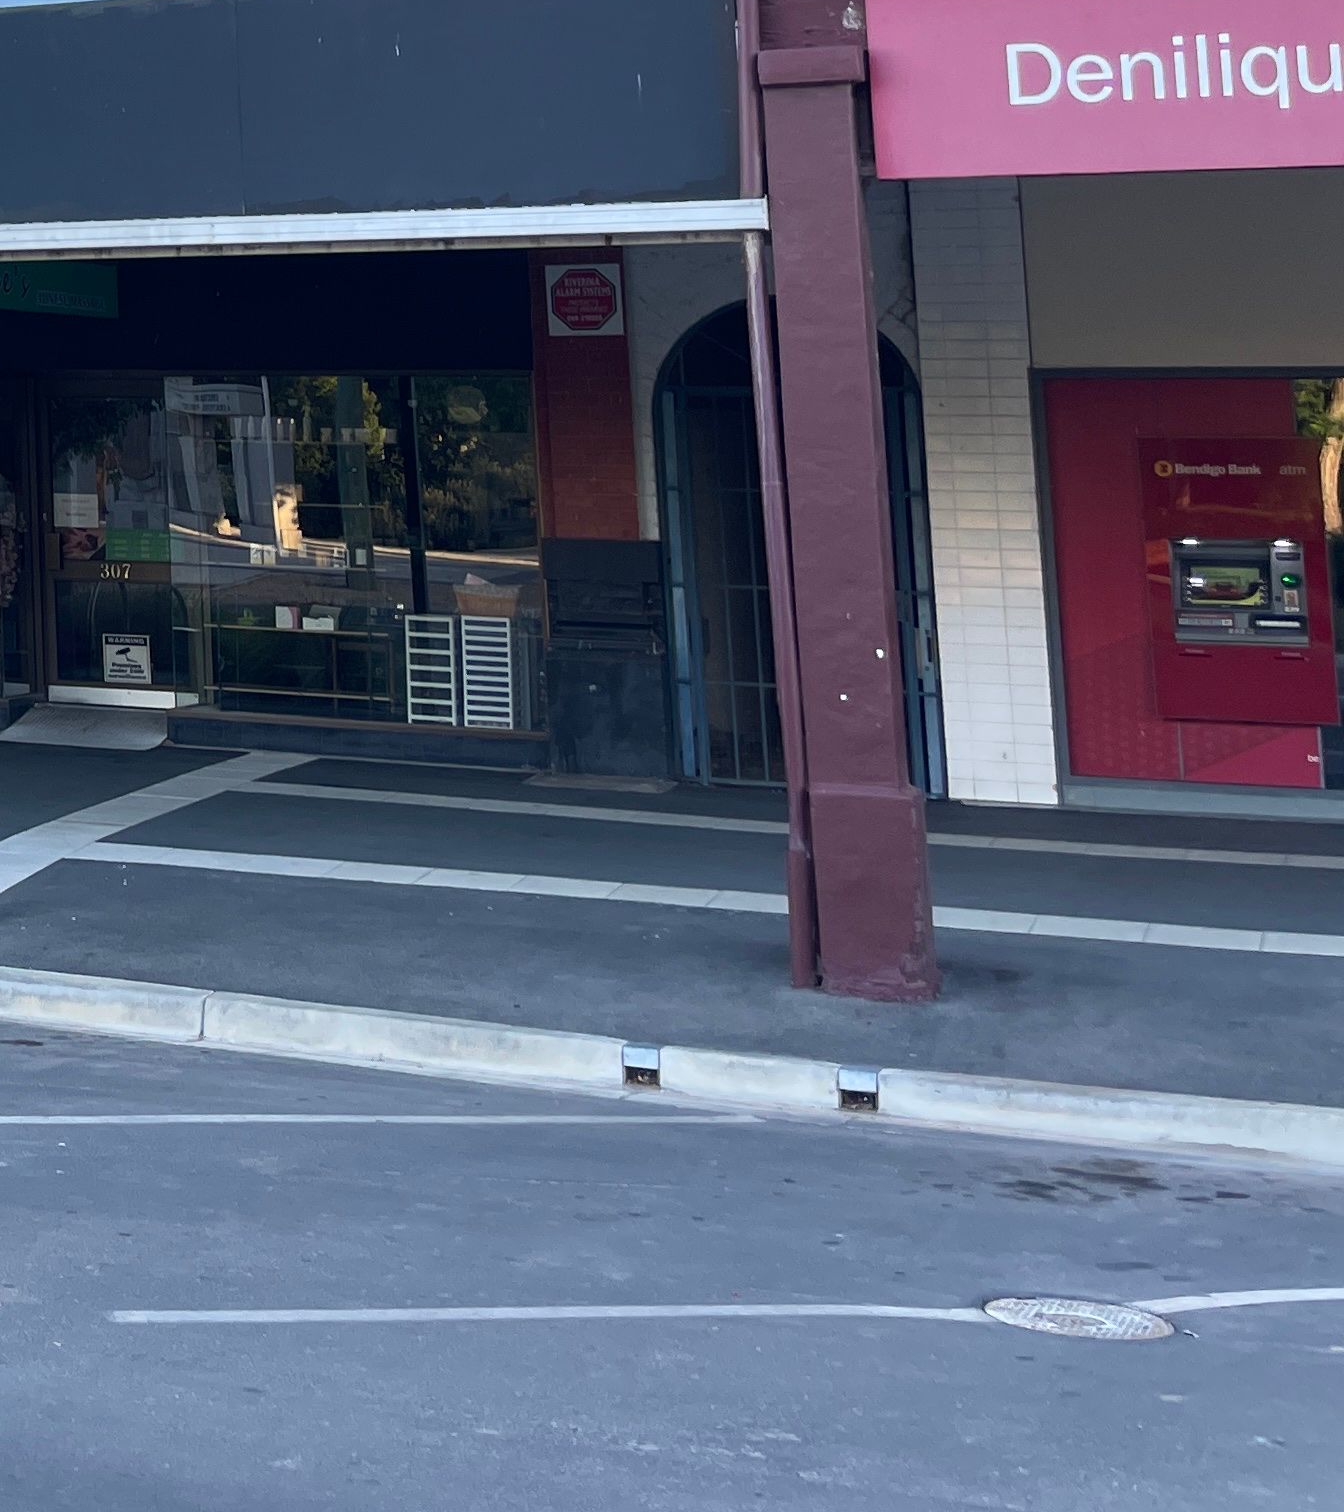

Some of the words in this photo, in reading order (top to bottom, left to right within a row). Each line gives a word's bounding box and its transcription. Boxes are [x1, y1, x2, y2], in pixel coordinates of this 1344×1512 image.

[1006, 33, 1343, 109] Deniliqu
[1175, 463, 1226, 477] Bendigo
[1228, 464, 1262, 475] Bank
[1279, 465, 1307, 475] atm
[100, 563, 131, 579] 307
[107, 636, 145, 645] WARNING
